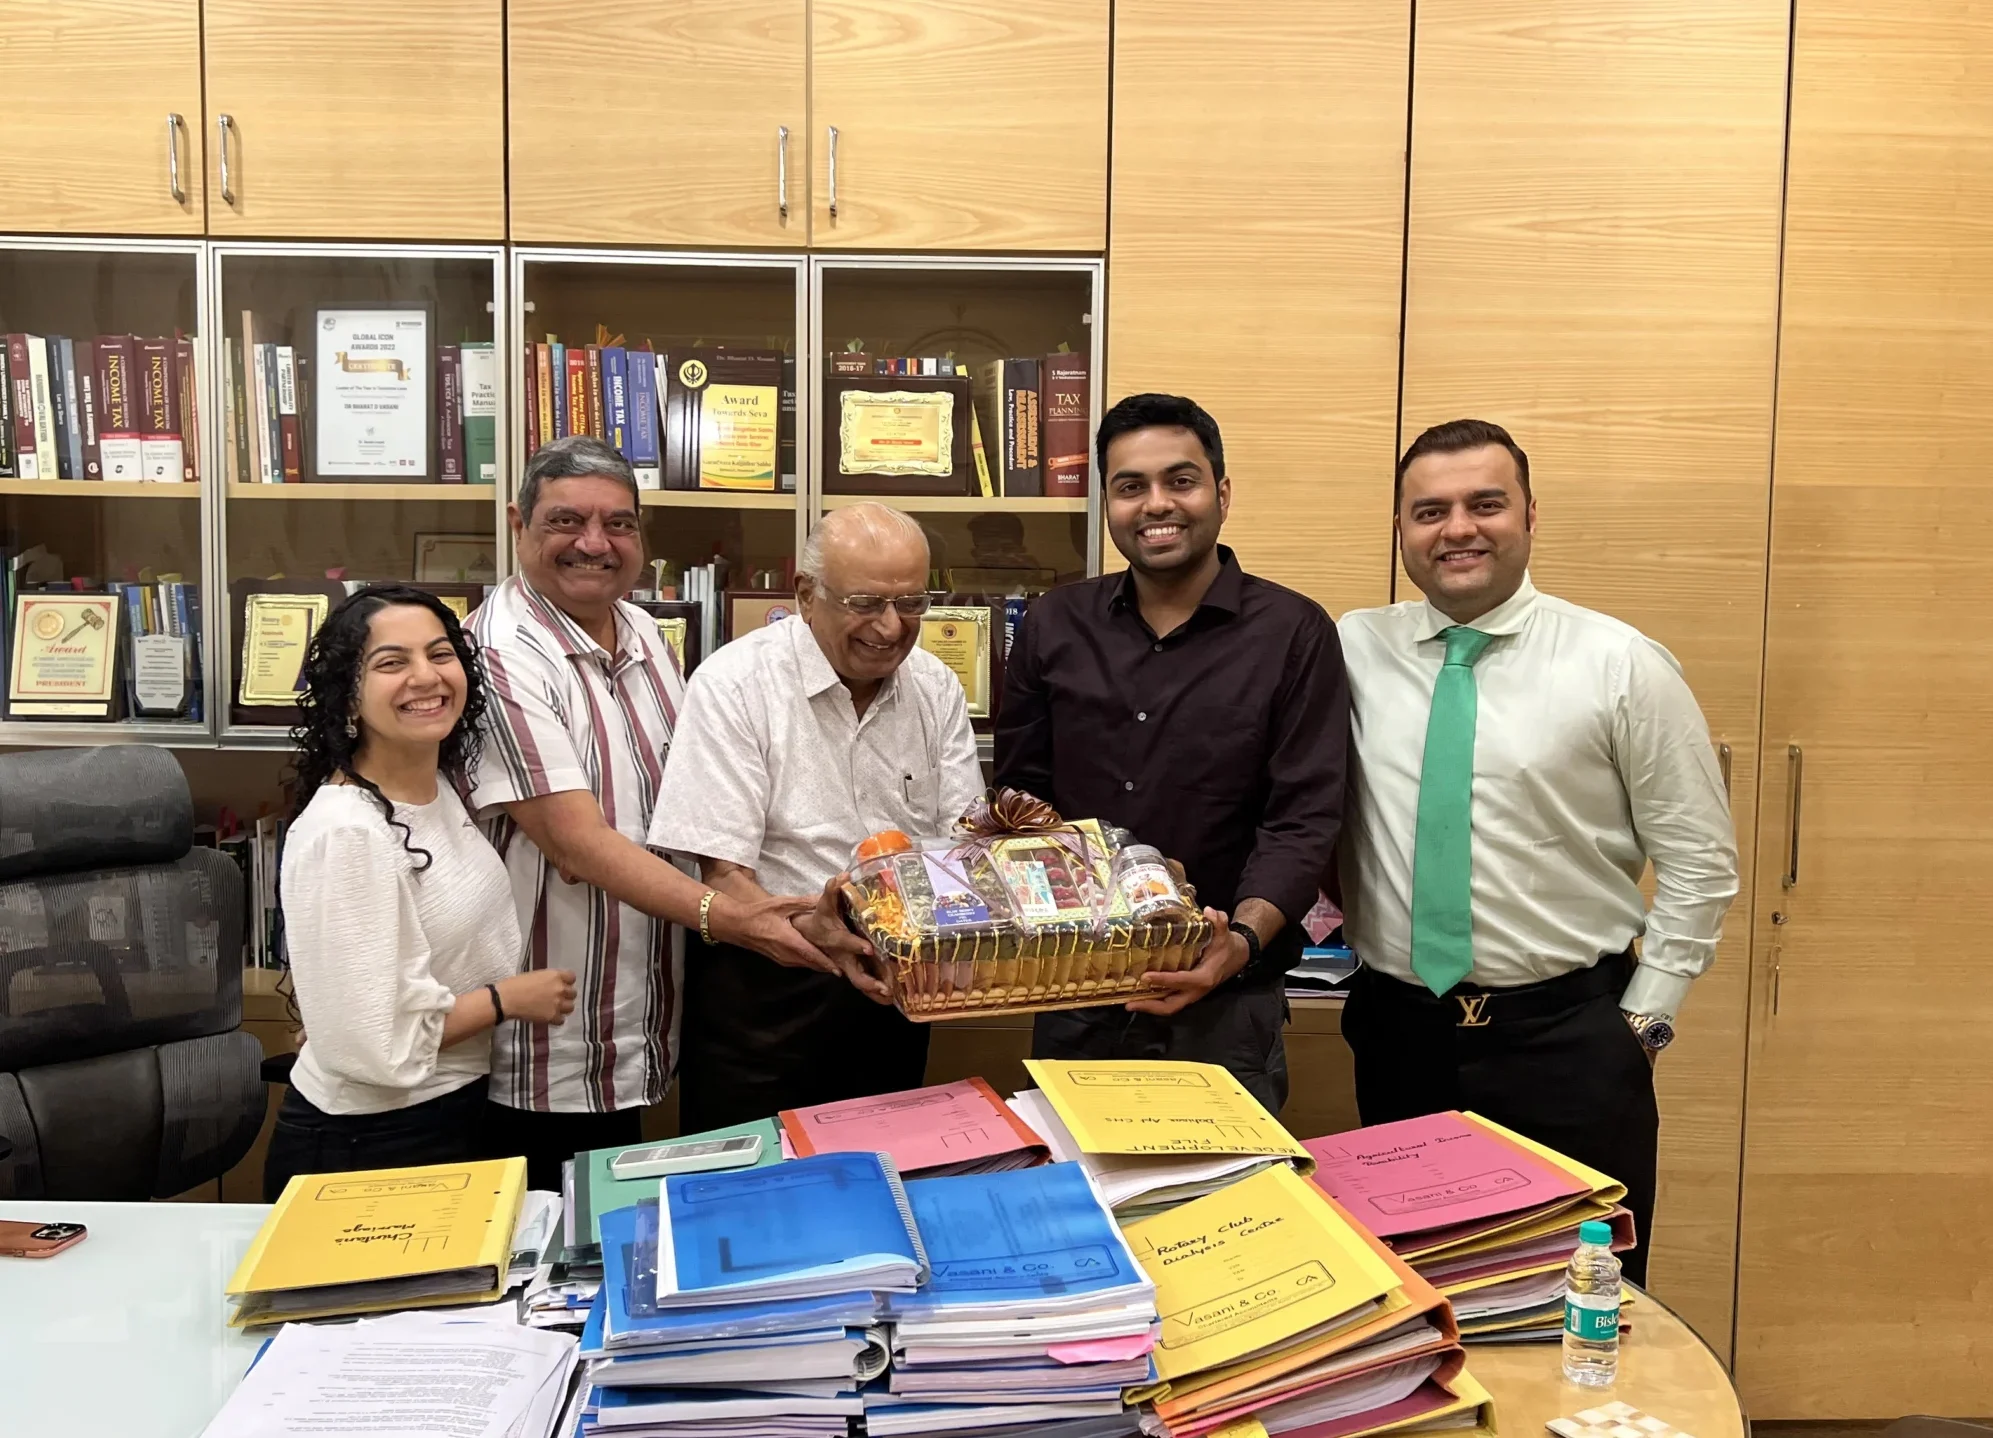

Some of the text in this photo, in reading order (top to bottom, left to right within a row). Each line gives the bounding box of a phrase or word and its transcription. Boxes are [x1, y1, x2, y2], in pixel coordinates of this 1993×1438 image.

[109, 355, 122, 404] INCOME
[152, 356, 163, 405] INCOME
[613, 376, 624, 407] INCOME
[1055, 393, 1080, 405] TAX
[721, 395, 758, 405] Award
[112, 407, 123, 428] TAX
[154, 408, 164, 429] TAX
[616, 409, 625, 424] TAX
[712, 408, 767, 418] Towards Seva
[1049, 407, 1088, 415] PLANNING
[1016, 390, 1027, 469] REASSESSMENT
[1027, 390, 1037, 467] ASSESSMENT &
[46, 644, 87, 654] Award
[1005, 622, 1014, 661] INCOM
[1125, 1144, 1296, 1154] REDEVELOPMENT
[1356, 1133, 1472, 1160] Agricultural Income
[400, 1182, 449, 1191] Vasani
[1385, 1193, 1443, 1203] Vasani
[342, 1223, 416, 1233] Marriage
[334, 1232, 412, 1246] Chintan's
[1157, 1216, 1253, 1256] Rotary Club
[1163, 1217, 1284, 1266] Dialysis Centre
[931, 1265, 997, 1278] Vasani
[1004, 1265, 1015, 1273] &
[1172, 1304, 1236, 1327] Vasani
[1198, 1314, 1233, 1329] Chartered
